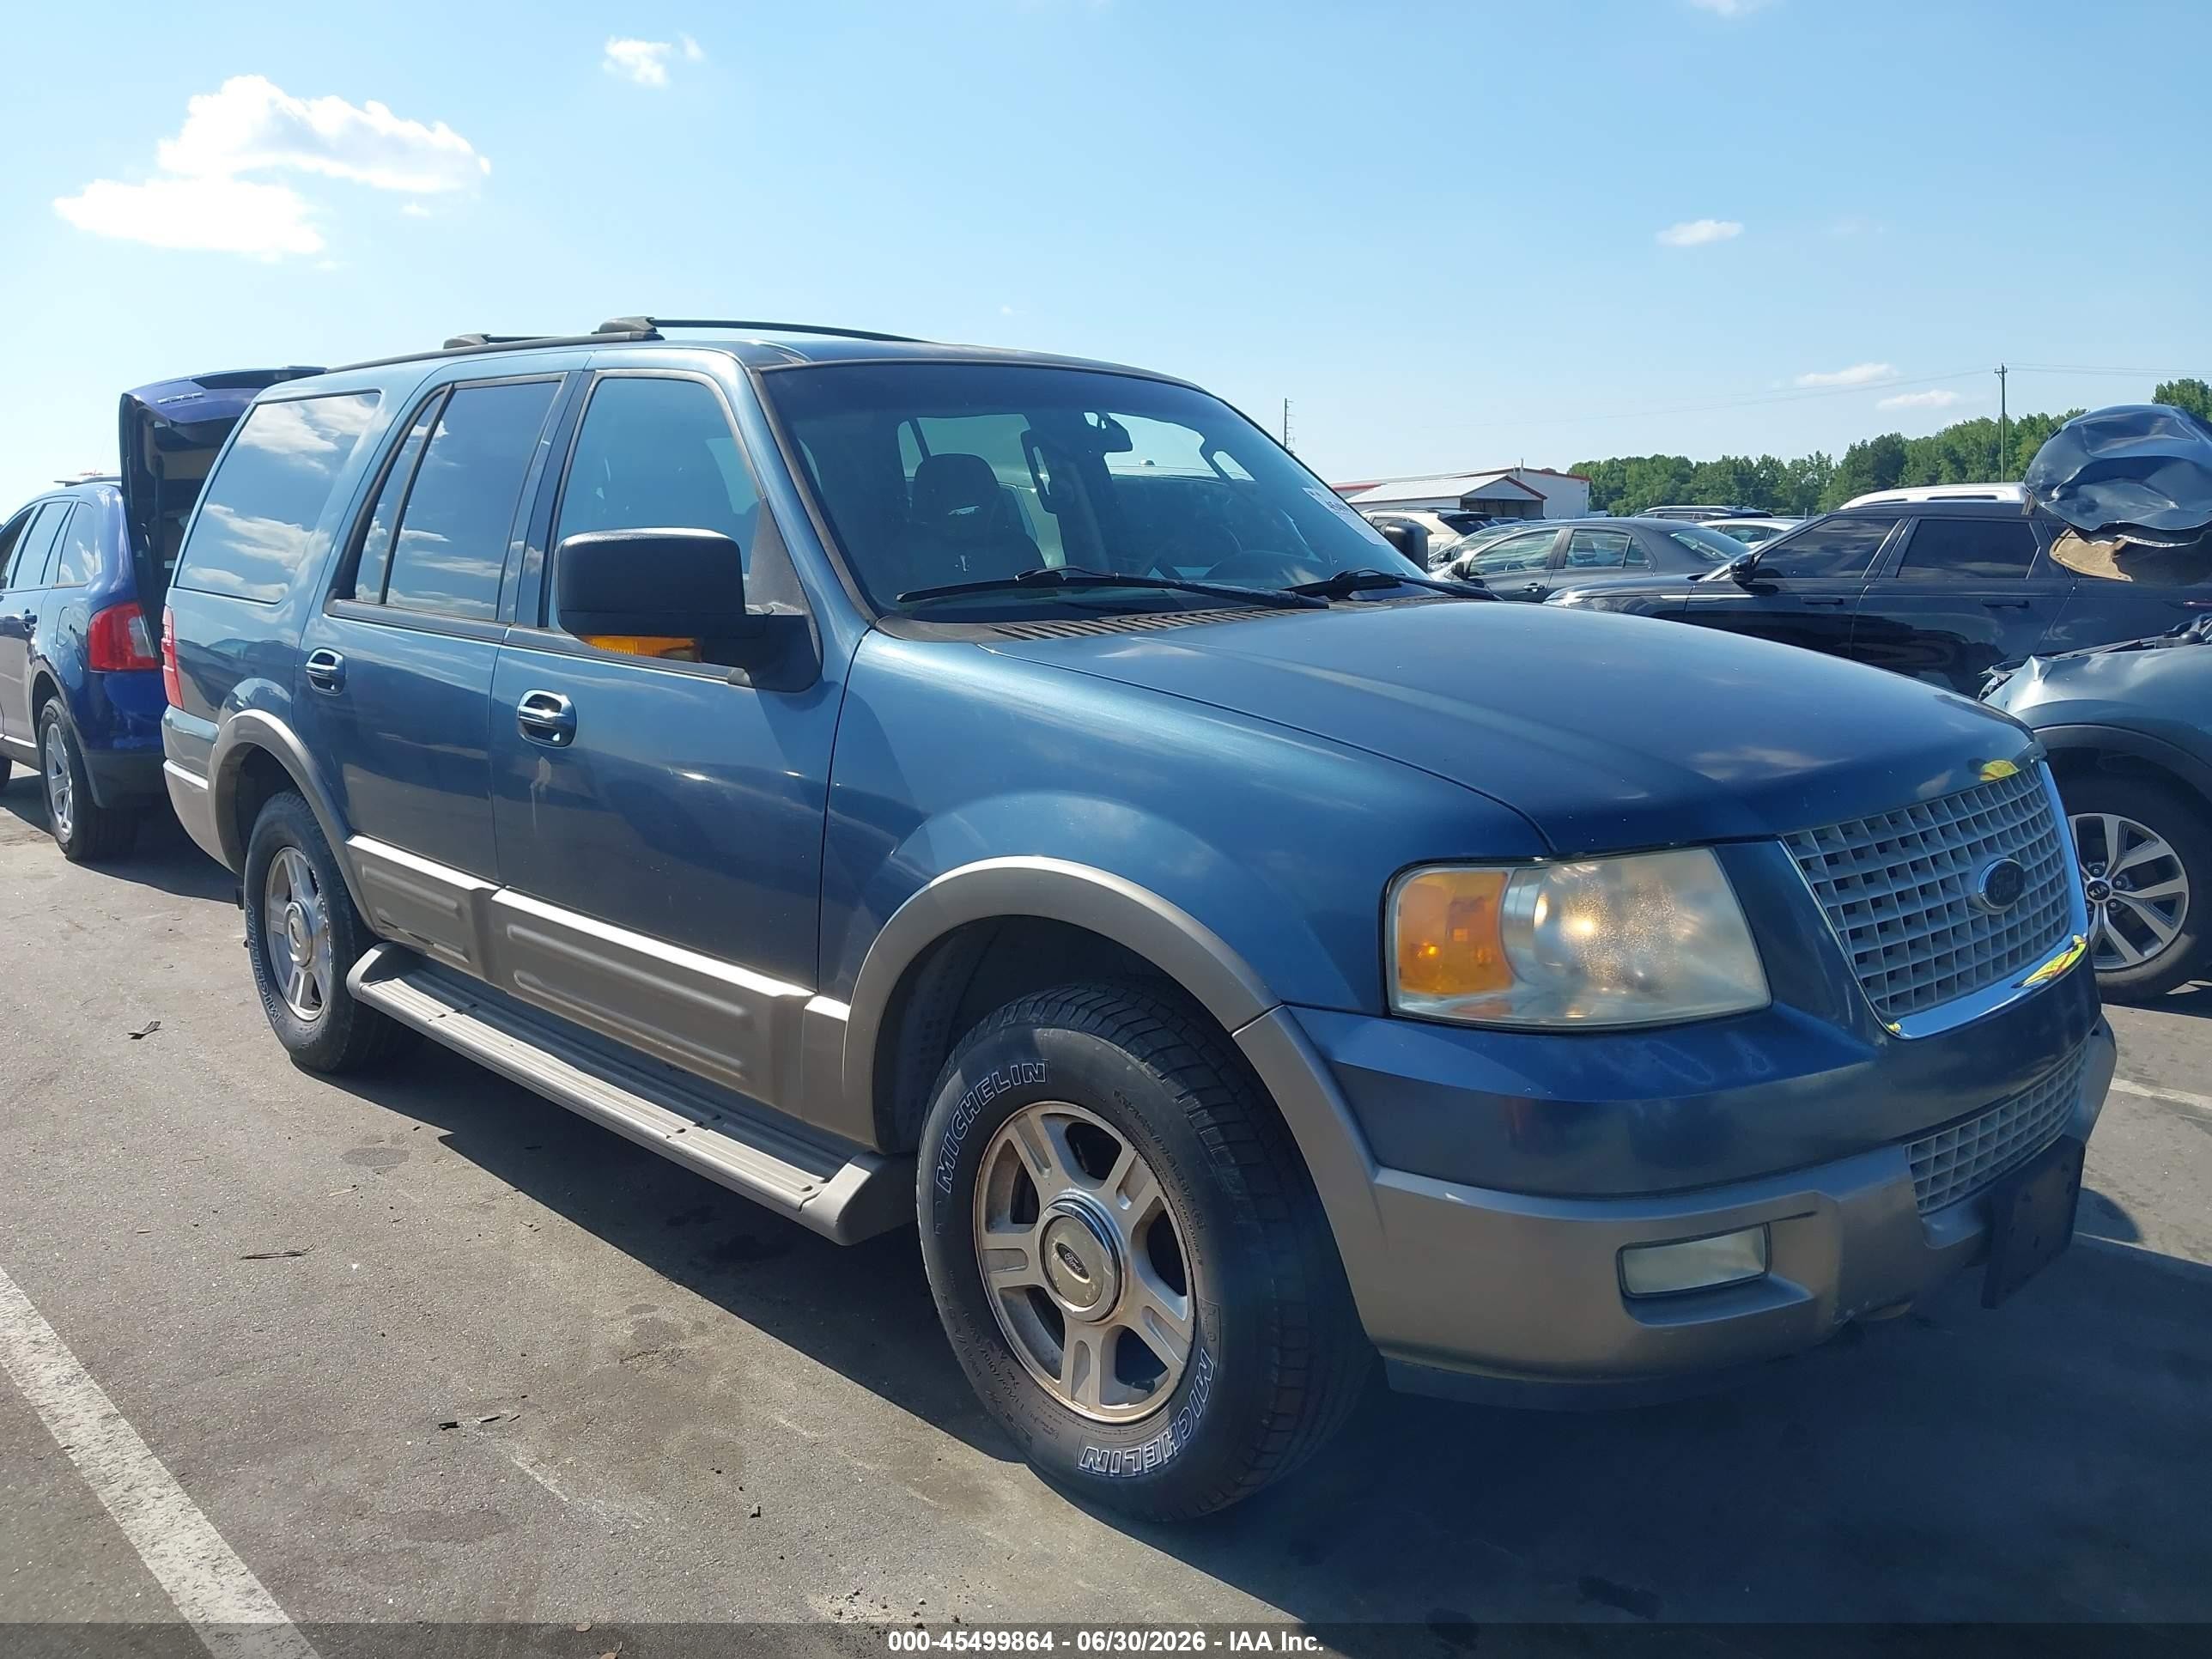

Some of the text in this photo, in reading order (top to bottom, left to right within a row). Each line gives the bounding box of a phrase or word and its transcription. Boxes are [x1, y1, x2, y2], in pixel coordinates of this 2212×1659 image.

[1993, 867, 2021, 902] Ford
[934, 1062, 1047, 1194] MICHELIN
[1064, 1251, 1082, 1273] Ford
[1079, 1346, 1215, 1475] MICHELIN
